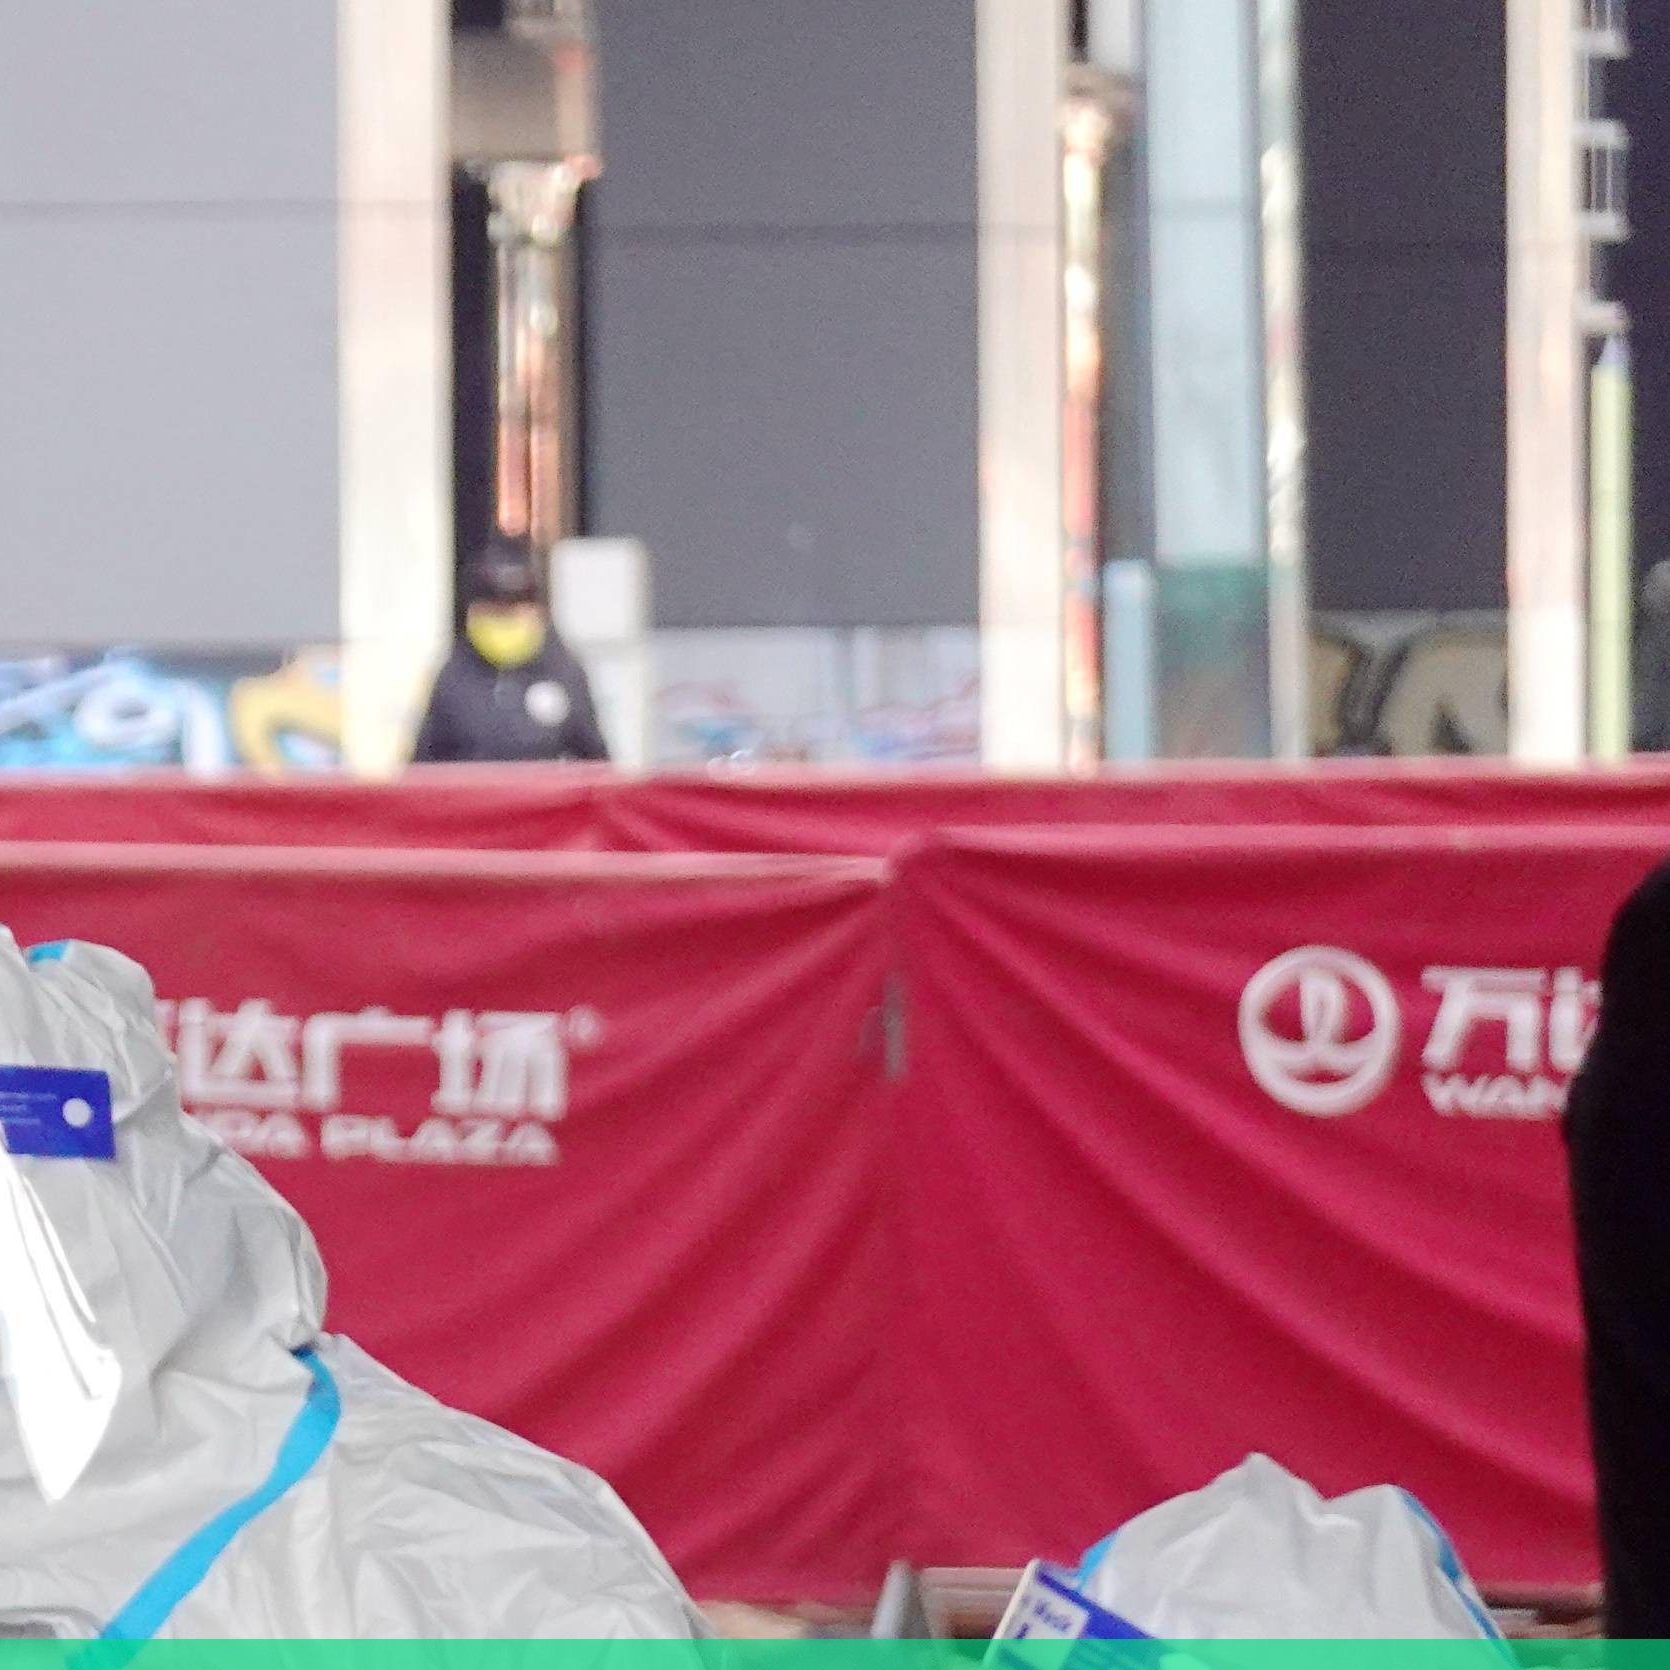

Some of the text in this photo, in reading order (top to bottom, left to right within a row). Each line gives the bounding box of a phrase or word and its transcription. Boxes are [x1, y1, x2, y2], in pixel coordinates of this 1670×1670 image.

[156, 998, 567, 1121] 达广场
[319, 1114, 559, 1166] PLAZA
